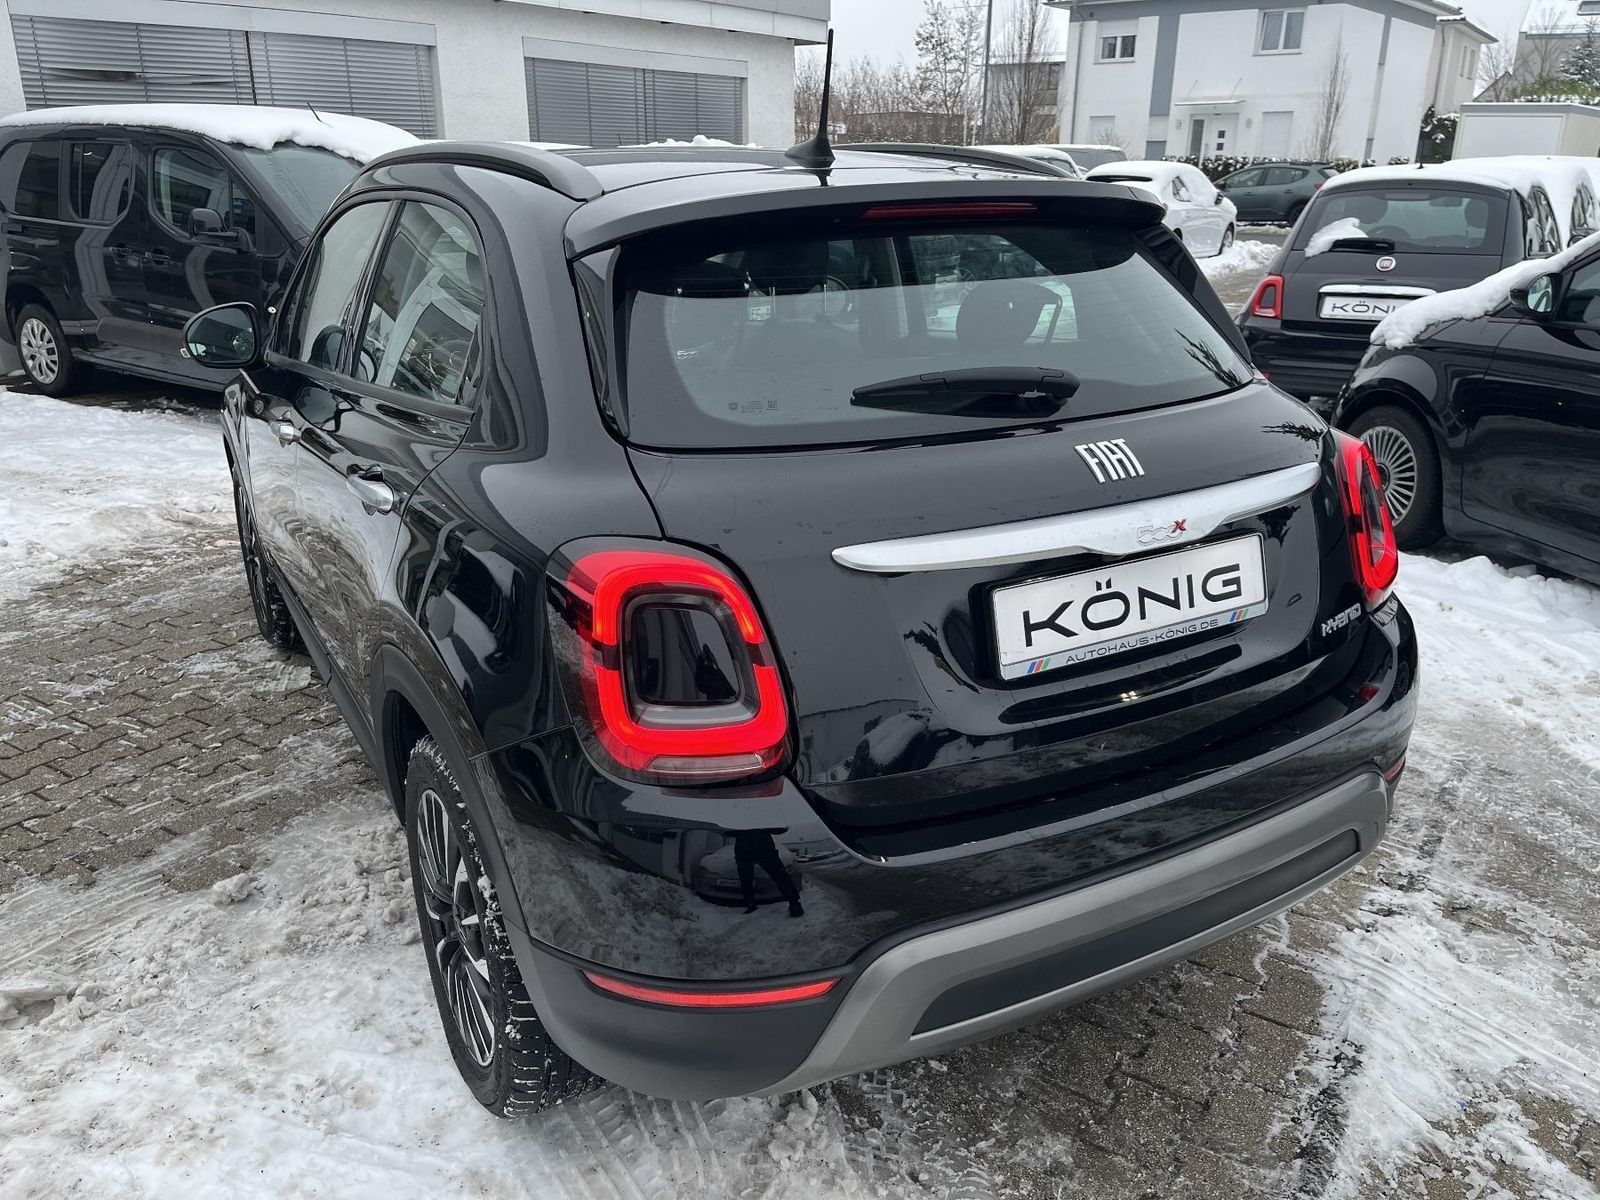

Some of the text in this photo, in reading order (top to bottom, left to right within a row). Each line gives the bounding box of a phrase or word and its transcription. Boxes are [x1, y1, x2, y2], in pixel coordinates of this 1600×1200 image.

[1331, 300, 1396, 314] KÖNI
[1074, 438, 1145, 485] FIAT
[1022, 563, 1243, 648] KÖNIG
[1065, 618, 1219, 664] AUTOHAUS-KÖNIG.DE
